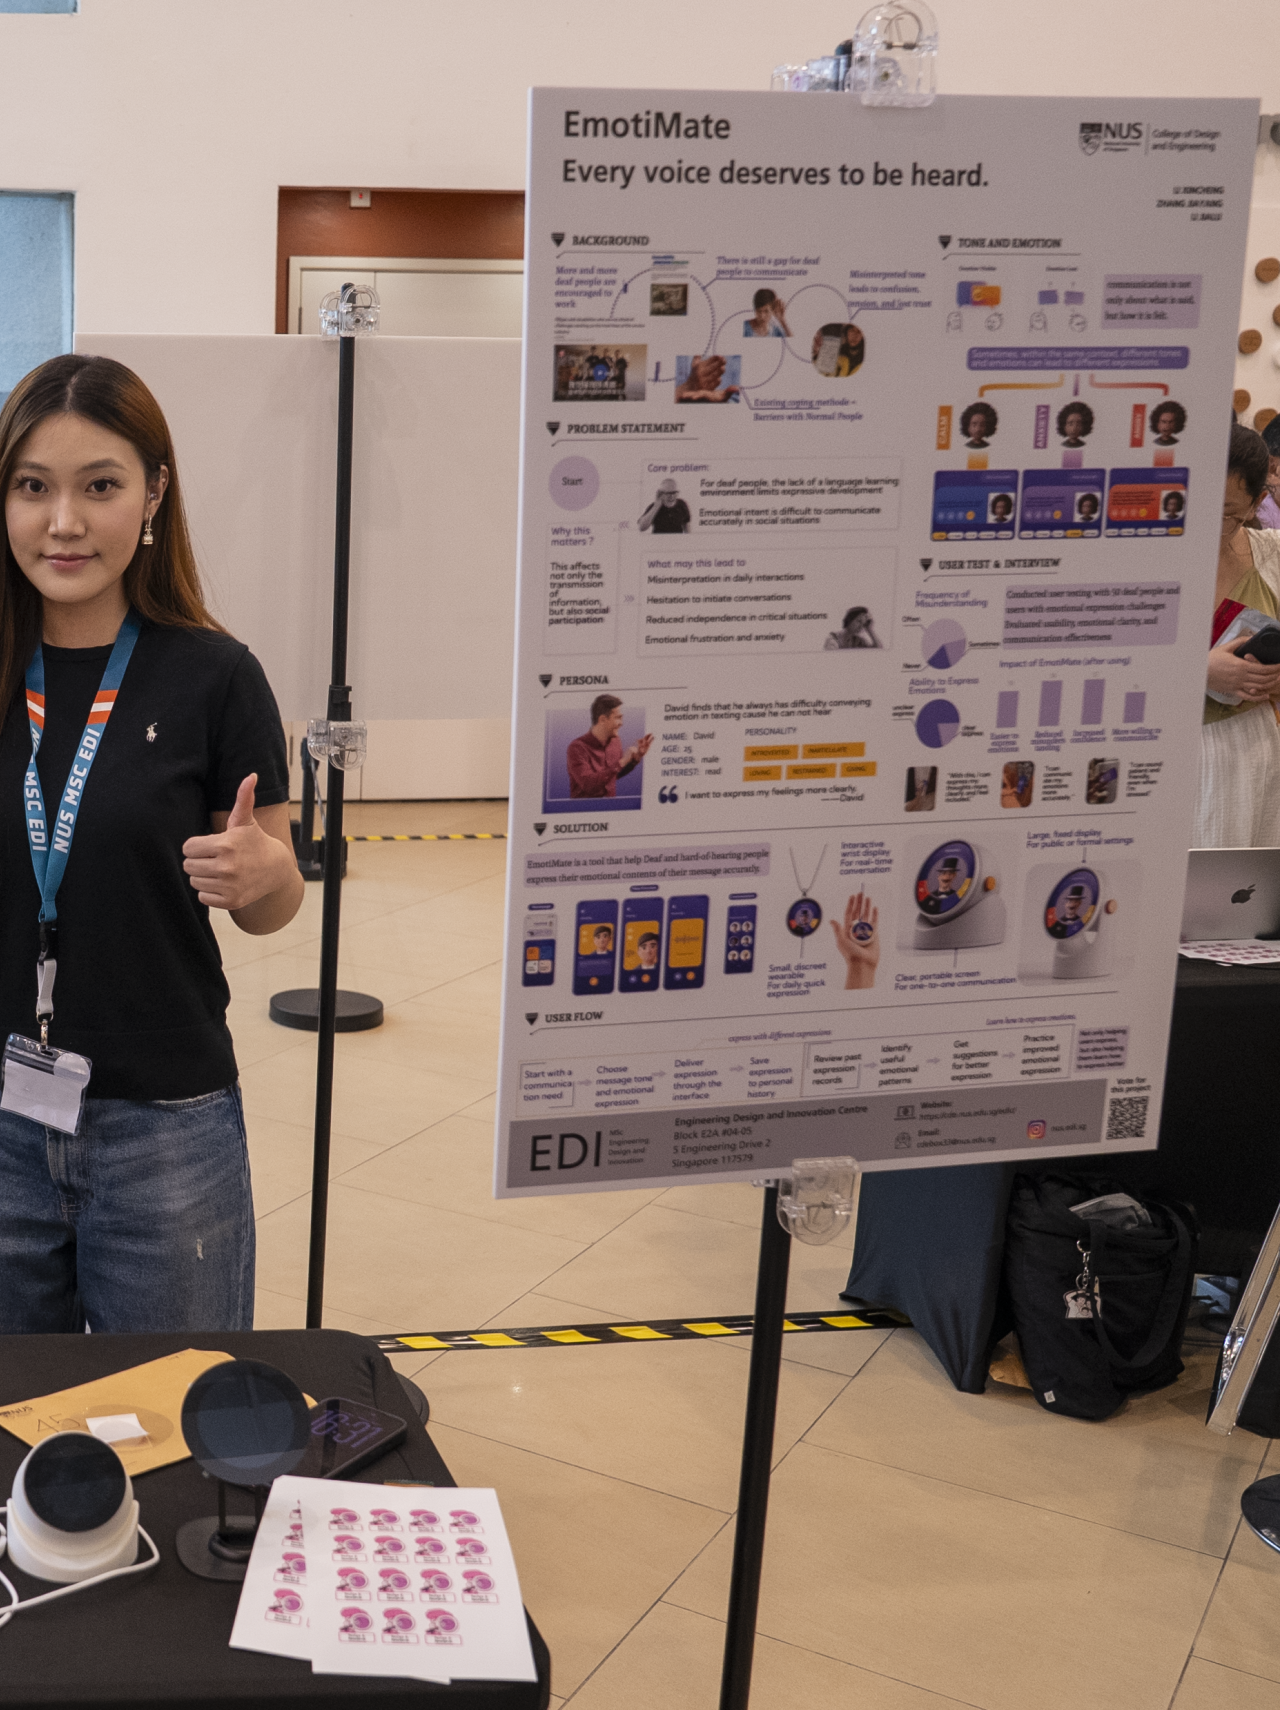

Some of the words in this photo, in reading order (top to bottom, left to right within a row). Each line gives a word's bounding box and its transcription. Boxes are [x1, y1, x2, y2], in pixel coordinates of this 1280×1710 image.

[564, 110, 730, 139] EmotiMate
[1104, 123, 1142, 139] NUS
[563, 160, 635, 188] Every
[644, 160, 710, 183] voice
[720, 160, 830, 185] deserves
[839, 164, 864, 185] to
[873, 162, 903, 186] be
[911, 163, 988, 187] heard.
[572, 236, 649, 246] BACKGROUND
[958, 239, 985, 248] TONE
[987, 238, 1010, 248] AND
[1012, 238, 1062, 248] EMOTION
[555, 278, 572, 286] deaf
[575, 279, 602, 287] people
[555, 290, 601, 298] encouraged
[567, 424, 618, 434] PROBLEM
[621, 423, 685, 433] STATEMENT
[938, 416, 947, 444] CALM
[648, 464, 667, 472] Core
[670, 464, 709, 473] problem:
[551, 527, 570, 536] Why
[939, 560, 964, 570] USER
[967, 560, 990, 569] TEST
[994, 560, 1000, 568] &
[1005, 558, 1061, 568] INTERVIEW
[567, 572, 585, 581] only
[647, 575, 720, 585] Misinterpretation
[723, 574, 731, 583] in
[733, 573, 752, 584] daily
[756, 573, 804, 582] interactions
[550, 590, 558, 598] of
[647, 596, 689, 604] Hesitation
[692, 595, 700, 603] to
[703, 594, 731, 603] initiate
[734, 593, 791, 602] conversations
[549, 599, 601, 607] information,
[549, 608, 563, 616] but
[549, 617, 603, 627] participation
[646, 615, 684, 625] Reduced
[686, 613, 746, 625] independence
[749, 613, 756, 621] in
[758, 612, 785, 621] critical
[788, 612, 827, 621] situations
[645, 635, 688, 644] Emotional
[690, 634, 734, 643] frustration
[737, 634, 752, 642] and
[754, 633, 784, 642] anxiety
[560, 676, 609, 685] PERSONA
[662, 733, 687, 741] NAME:
[693, 731, 714, 740] David
[745, 727, 797, 736] PERSONALITY
[25, 771, 42, 811] MSC
[54, 810, 74, 854] NUS
[65, 765, 87, 807] MSC
[79, 728, 100, 761] EDI
[553, 823, 608, 834] SOLUTION
[29, 818, 47, 851] EDI
[527, 859, 572, 868] EmotiMate
[589, 857, 605, 866] tool
[607, 856, 622, 865] that
[624, 855, 641, 865] help
[644, 854, 661, 863] Deaf
[662, 854, 678, 862] and
[680, 850, 741, 861] hard-of-hearing
[743, 849, 769, 860] people
[527, 875, 557, 885] express
[559, 873, 578, 882] their
[580, 871, 620, 881] emotional
[622, 870, 656, 879] contents
[658, 869, 667, 877] of
[668, 868, 687, 877] their
[689, 866, 721, 877] message
[545, 1013, 572, 1023] USER
[574, 1011, 603, 1021] FLOW
[674, 1113, 730, 1127] Engineering
[733, 1111, 765, 1124] Design
[767, 1109, 784, 1120] and
[787, 1105, 836, 1118] Innovation
[837, 1104, 868, 1115] Centre
[674, 1129, 697, 1140] Block
[701, 1127, 719, 1138] E2A
[722, 1125, 752, 1137] #04-05
[530, 1131, 602, 1172] EDI
[673, 1144, 679, 1154] 5
[681, 1140, 737, 1154] Engineering
[738, 1139, 763, 1150] Drive
[765, 1139, 770, 1148] 2
[672, 1154, 718, 1167] Singapore
[721, 1153, 753, 1164] 117579
